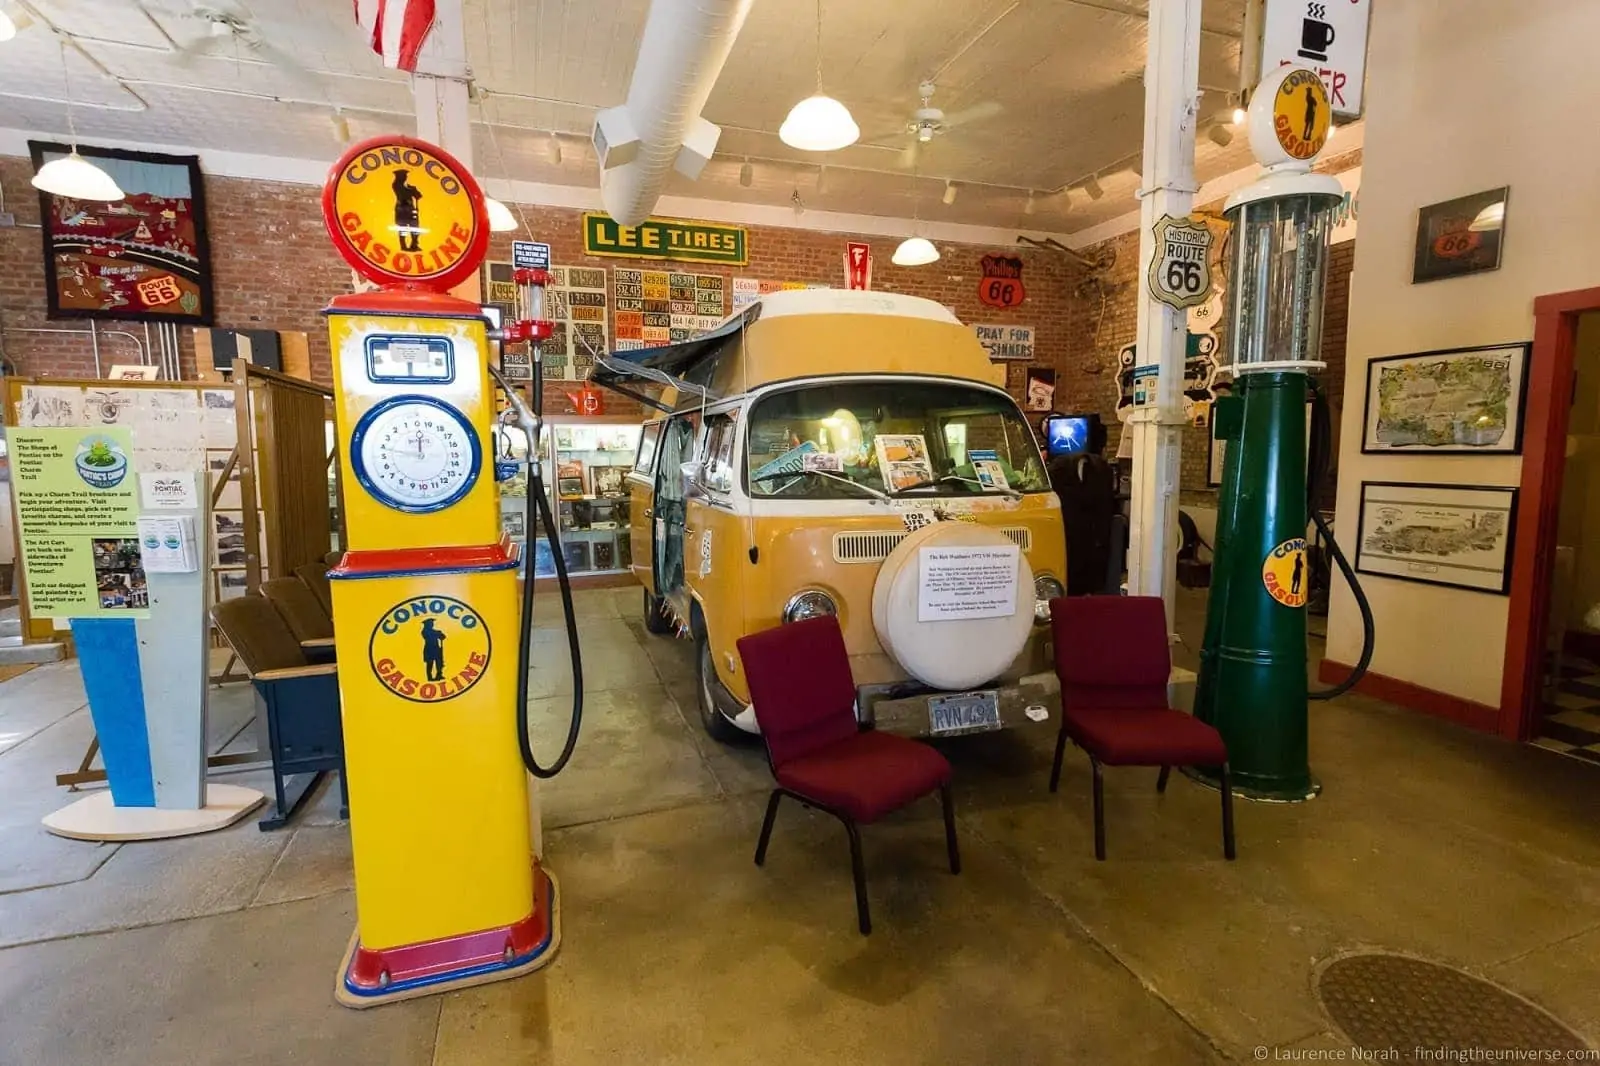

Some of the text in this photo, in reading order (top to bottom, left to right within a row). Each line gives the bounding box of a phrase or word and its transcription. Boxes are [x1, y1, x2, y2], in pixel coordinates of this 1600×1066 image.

[346, 147, 460, 195] CONOCO
[342, 212, 470, 274] GASOLINE
[596, 223, 736, 250] LEE TIRES
[1169, 230, 1206, 244] HISTORIC
[1168, 244, 1205, 261] ROUTE
[141, 279, 173, 291] ROUTE
[1167, 261, 1201, 293] 66
[145, 287, 175, 303] 66
[989, 281, 1015, 304] 66
[1197, 308, 1209, 317] 66
[976, 327, 1030, 341] PRAY FOR
[990, 343, 1032, 357] SINNERS
[1274, 540, 1305, 558] CONO
[382, 600, 477, 635] CONOCO
[377, 652, 486, 699] GASOLINE
